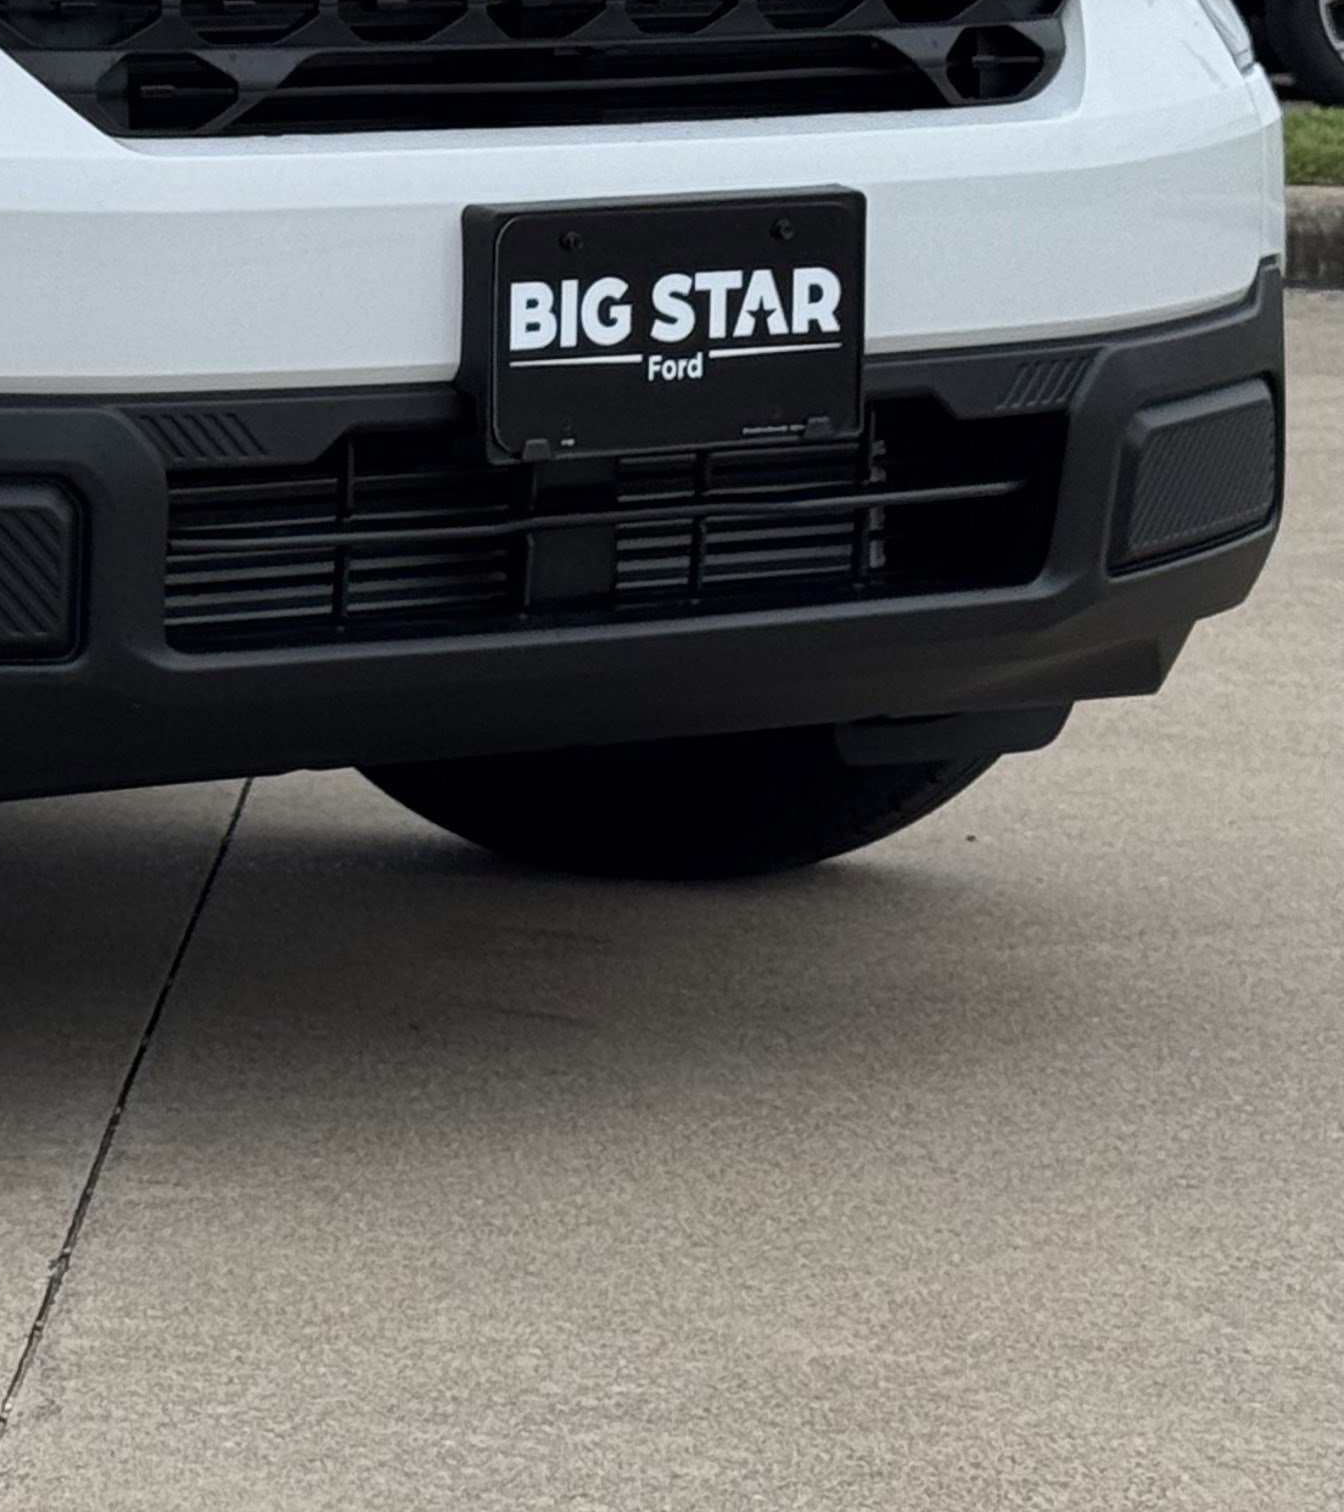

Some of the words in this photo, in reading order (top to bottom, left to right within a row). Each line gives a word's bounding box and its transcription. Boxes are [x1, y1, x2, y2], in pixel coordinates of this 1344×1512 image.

[509, 276, 633, 351] BIG
[650, 266, 843, 343] STAR
[647, 351, 703, 381] Ford
